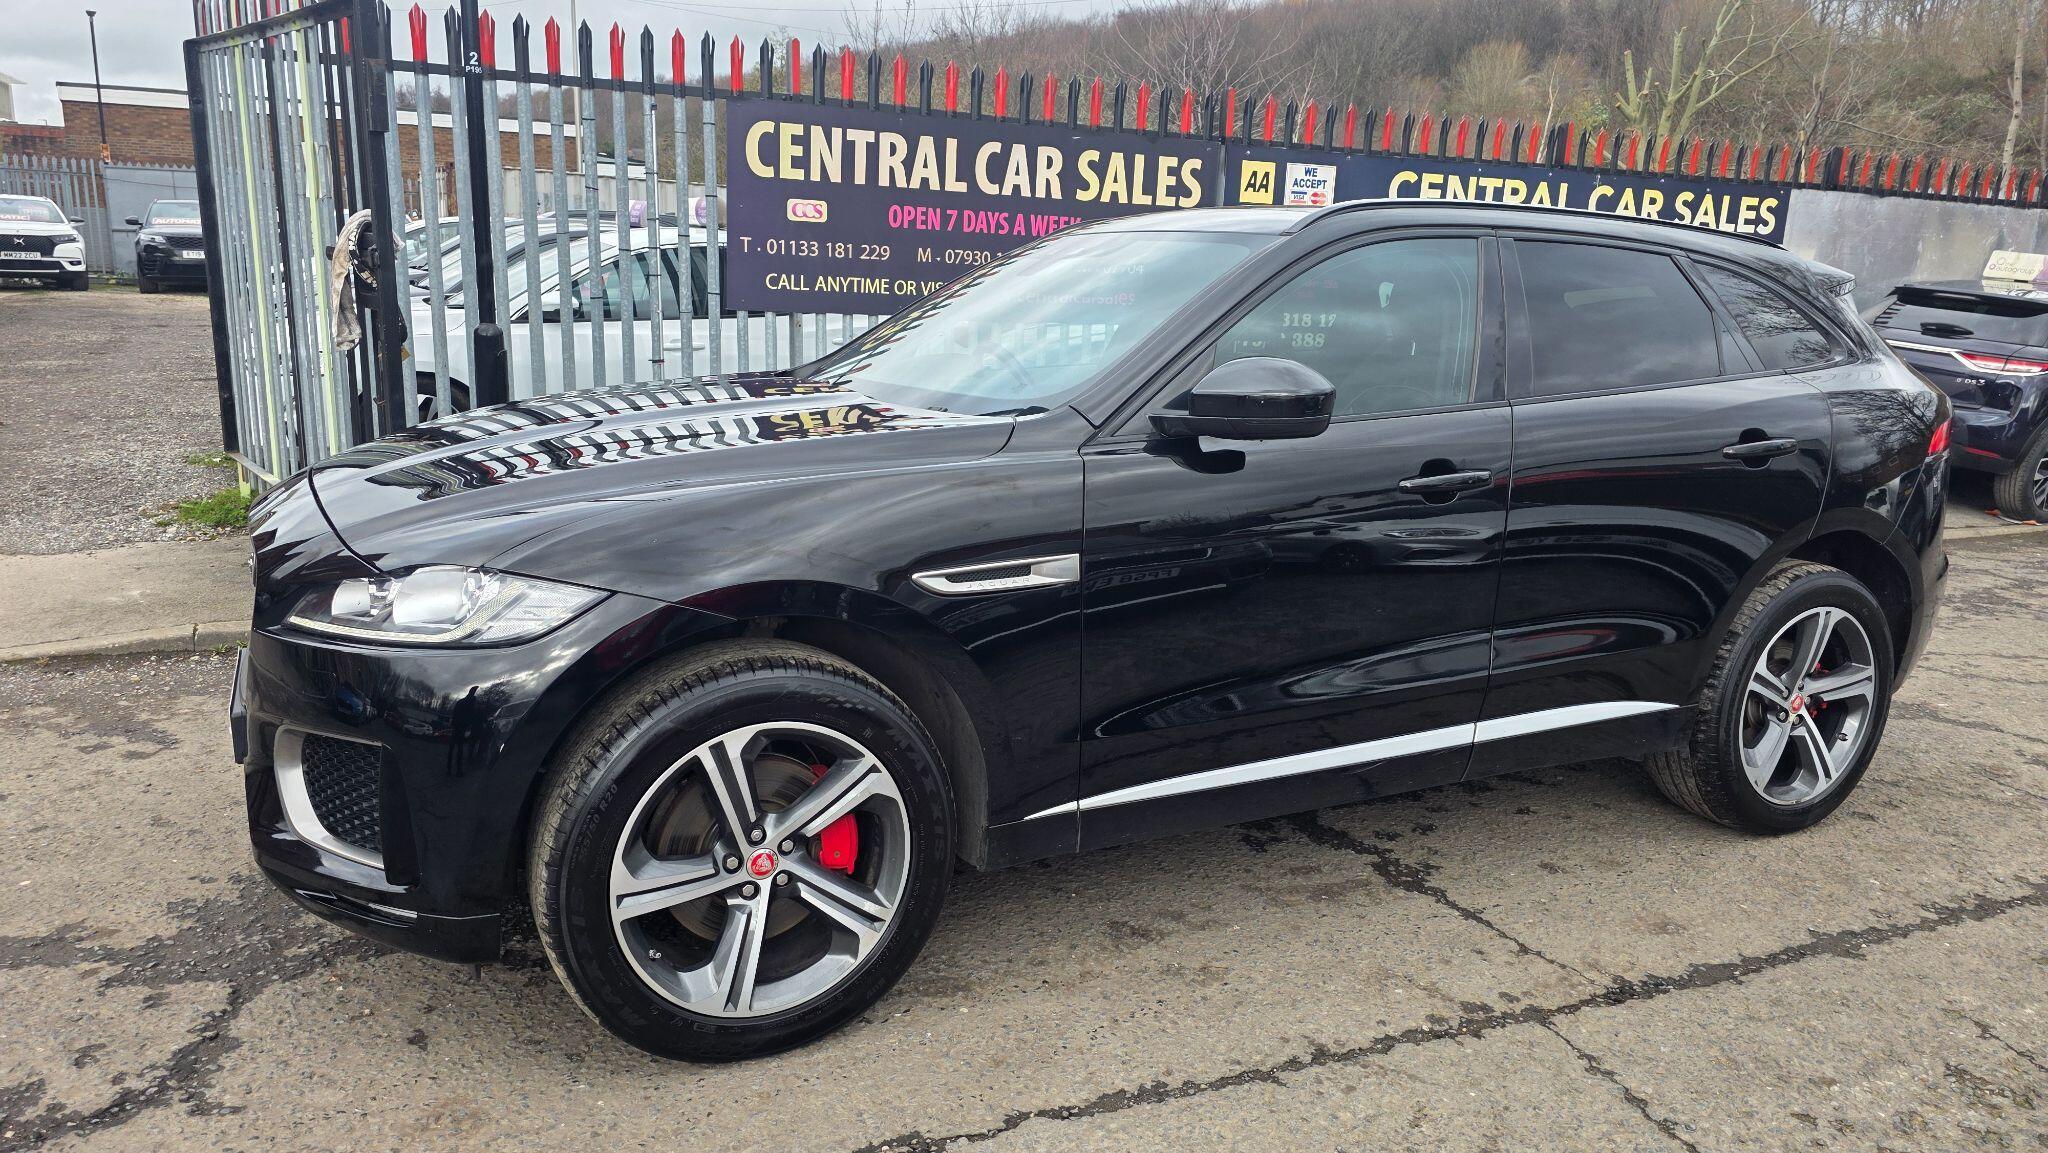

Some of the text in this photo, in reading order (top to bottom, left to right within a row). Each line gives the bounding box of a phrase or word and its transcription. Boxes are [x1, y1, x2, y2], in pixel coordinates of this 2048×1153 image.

[470, 51, 478, 65] 2
[745, 120, 1203, 208] CENTRAL CAR SALES
[1304, 167, 1318, 178] WE
[1244, 170, 1270, 193] AA
[1292, 178, 1327, 190] ACCEPT
[791, 202, 824, 220] CCS
[1388, 170, 1779, 235] CENTRAL CAR SALES
[888, 204, 941, 231] OPEN
[946, 209, 958, 232] 7
[962, 209, 1010, 235] DAYS
[1013, 213, 1026, 237] A
[766, 238, 819, 257] 01133
[826, 242, 853, 259] 181
[858, 244, 890, 261] 229
[945, 249, 991, 266] 07930
[765, 273, 810, 291] CALL
[814, 275, 890, 295] ANYTIME
[894, 280, 917, 296] OR
[1282, 312, 1312, 328] 318
[966, 577, 1030, 589] JAGUAR
